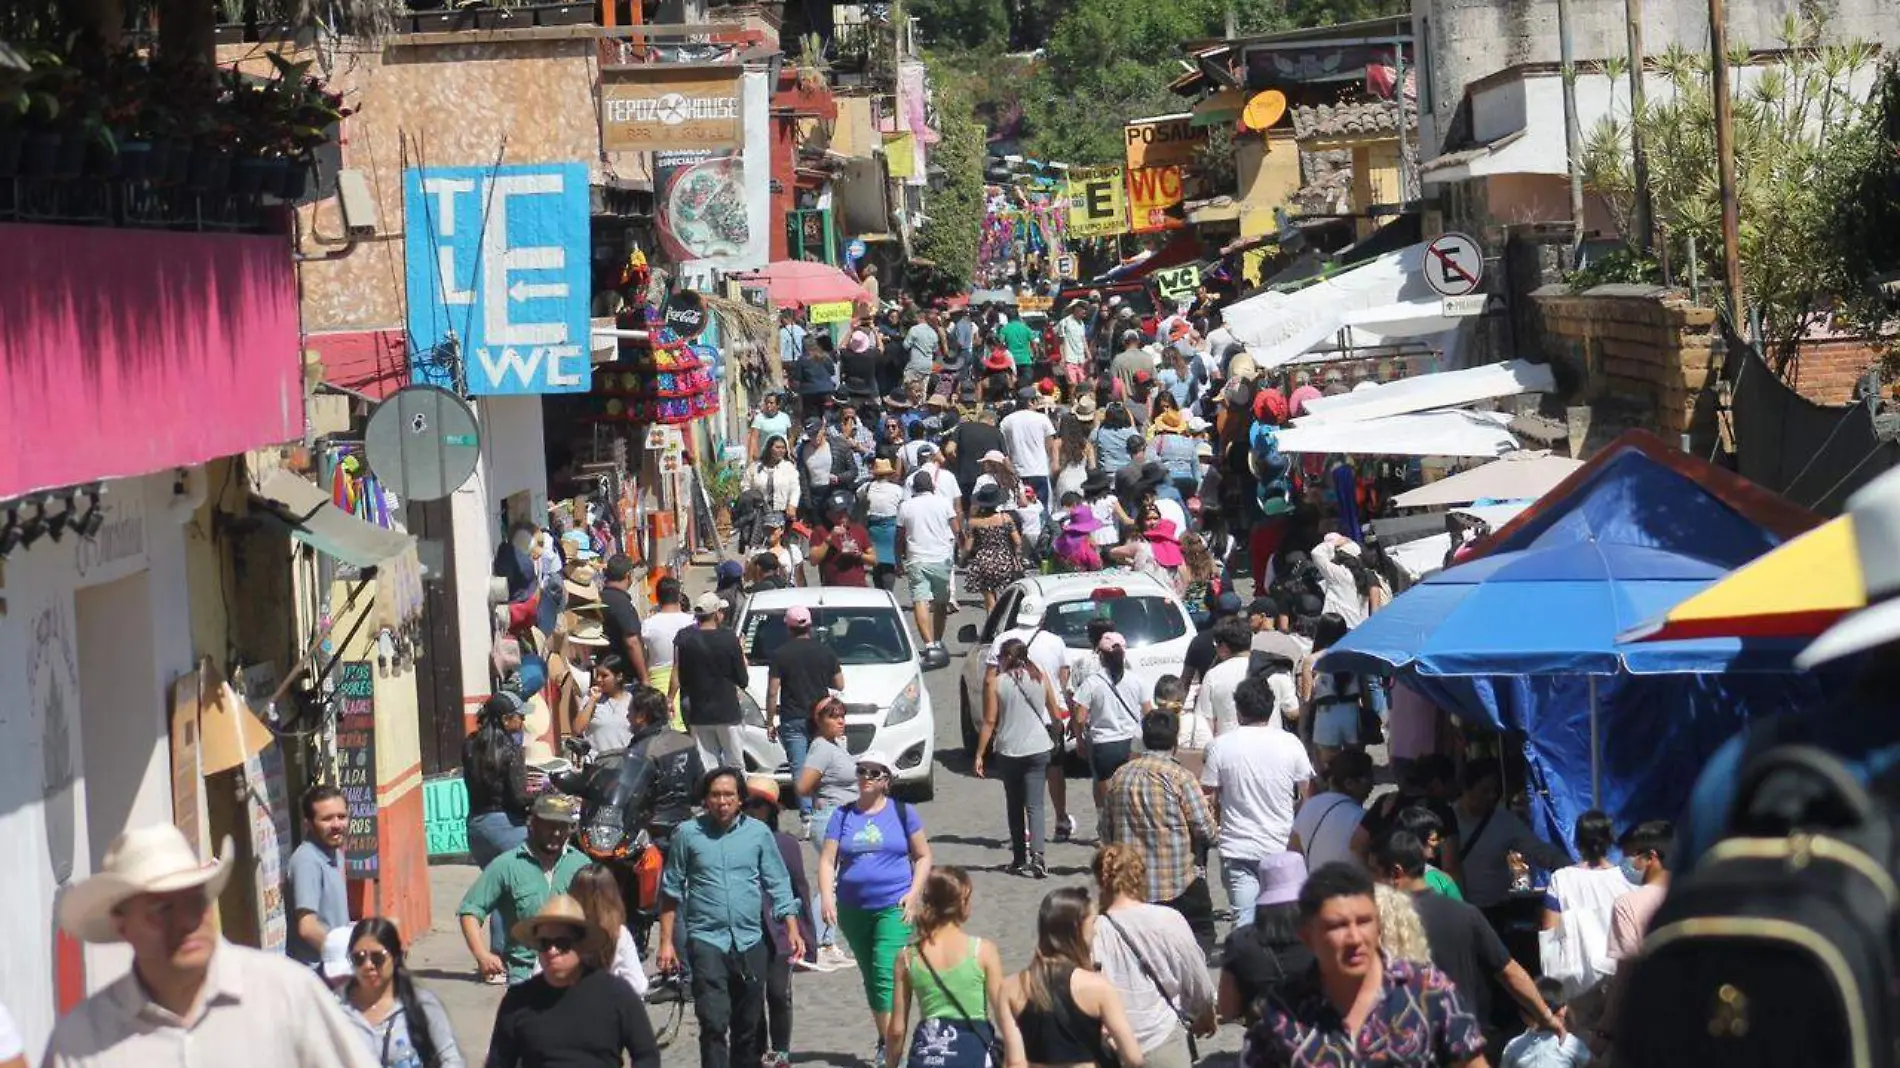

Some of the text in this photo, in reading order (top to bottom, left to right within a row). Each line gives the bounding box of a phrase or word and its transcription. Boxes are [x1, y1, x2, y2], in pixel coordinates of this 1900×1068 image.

[606, 98, 739, 121] TEPOZ HOUSE
[1131, 166, 1181, 201] WC
[1087, 181, 1113, 218] E
[482, 174, 567, 346] E
[1440, 247, 1467, 283] E
[1158, 270, 1193, 289] WC
[665, 306, 700, 324] Coca-Cola
[476, 344, 583, 388] WC
[338, 769, 366, 785] LADA
[348, 818, 371, 834] ROS
